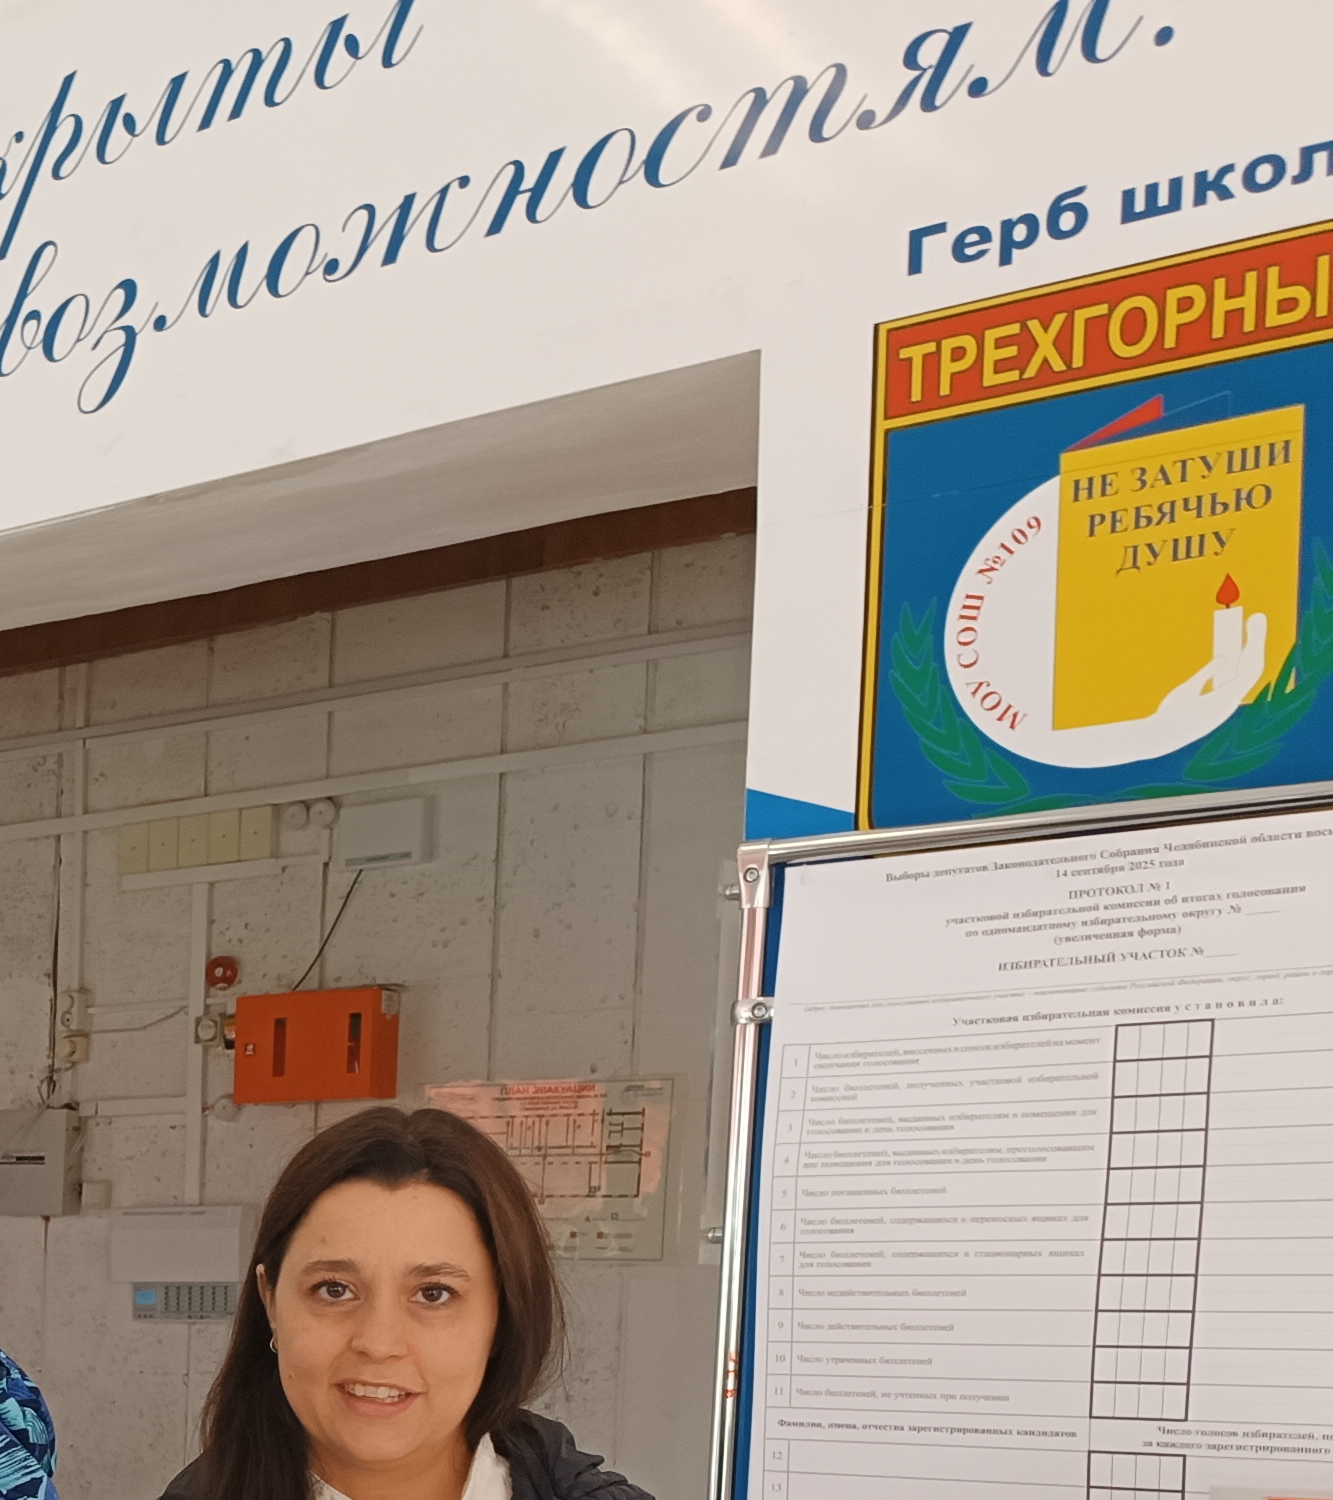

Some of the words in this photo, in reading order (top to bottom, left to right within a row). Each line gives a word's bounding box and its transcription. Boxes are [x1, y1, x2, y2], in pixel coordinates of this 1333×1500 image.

[907, 184, 1090, 276] Герб
[898, 253, 1333, 405] ТРЕХГОРНЫ
[1071, 470, 1121, 503] НЕ
[1130, 438, 1294, 494] ЗАТУШИ
[1086, 482, 1273, 538] РЕБЯЧЬЮ
[975, 515, 1042, 585] №109
[1115, 527, 1237, 576] ДУШУ
[956, 593, 985, 669] СОШ
[965, 680, 1028, 731] МОУ
[886, 870, 930, 883] Выборы
[932, 864, 988, 881] депутатов
[991, 852, 1097, 874] Законодательного
[1100, 844, 1159, 861] Собрания
[1163, 835, 1247, 852] Челябинской
[1250, 832, 1302, 844] области
[1055, 869, 1069, 879] 14
[1071, 862, 1125, 878] сентября
[1159, 857, 1185, 868] года
[1068, 884, 1144, 900] ПРОТОКОЛ
[1147, 881, 1162, 892] №
[945, 910, 1010, 929] участковой
[1012, 902, 1100, 922] избирательной
[1102, 899, 1161, 912] комиссии
[1163, 894, 1179, 905] об
[1181, 892, 1222, 905] итогах
[1225, 884, 1307, 901] голосования
[965, 930, 978, 939] по
[1080, 911, 1179, 931] избирательному
[1181, 906, 1223, 921] округу
[1053, 928, 1135, 947] (увеличенная
[1137, 924, 1182, 942] форма)
[997, 951, 1117, 973] ИЗБИРАТЕЛЬНЫЙ
[1120, 947, 1187, 964] УЧАСТОК
[951, 1013, 1019, 1027] Участковая
[1021, 1007, 1111, 1024] избирательная
[1112, 1003, 1171, 1017] комиссия
[500, 1084, 530, 1096] ПЛАН
[774, 1353, 786, 1363] 10
[774, 1386, 784, 1396] 11
[862, 1422, 905, 1433] отчества
[907, 1424, 1014, 1438] зарегистрированных
[1016, 1429, 1078, 1439] кандидатов
[1242, 1429, 1319, 1442] избирателей,
[771, 1450, 783, 1461] 12
[1205, 1442, 1332, 1455] зарегистрированного
[771, 1482, 782, 1493] 13
